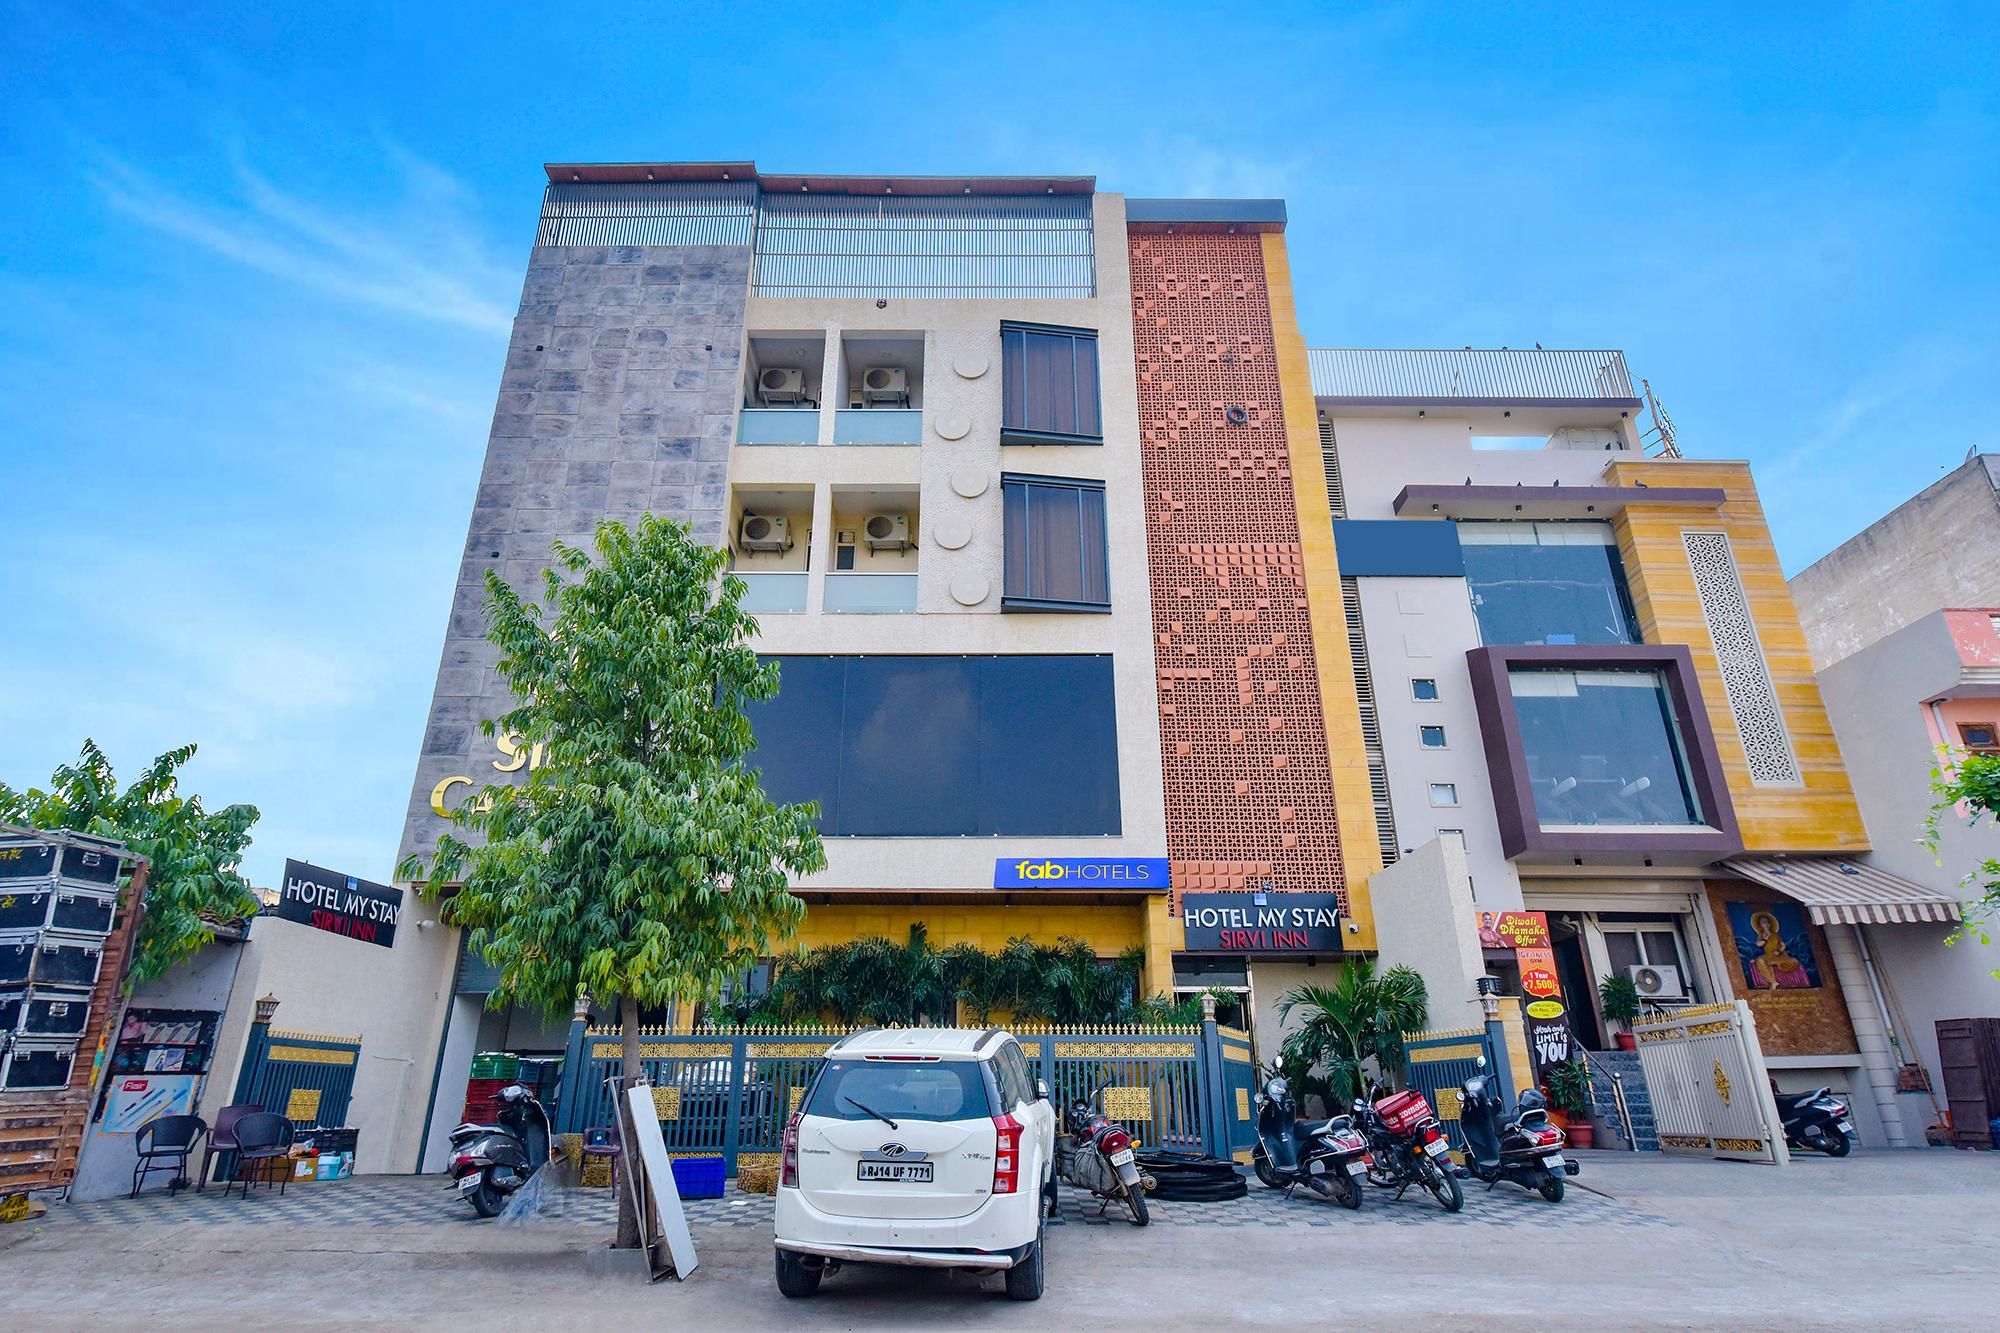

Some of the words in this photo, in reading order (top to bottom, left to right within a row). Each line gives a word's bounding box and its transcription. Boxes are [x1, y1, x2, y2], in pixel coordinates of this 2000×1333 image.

[1015, 860, 1149, 880] fabHOTELS
[286, 877, 341, 911] HOTEL
[343, 893, 369, 917] MY
[369, 899, 400, 925] STAY
[312, 908, 348, 937] SIRVI
[351, 918, 377, 942] INN
[1184, 908, 1249, 929] HOTEL
[1257, 908, 1285, 928] MY
[1291, 908, 1338, 928] STAY
[1506, 915, 1537, 926] Diwali
[1500, 924, 1546, 935] Dhamaka
[1220, 930, 1266, 949] SIRVI
[1272, 930, 1308, 949] INN
[1515, 935, 1537, 946] Offer
[1536, 1032, 1560, 1044] LIMIT
[1535, 1042, 1568, 1065] YOU
[125, 1081, 145, 1090] Flair
[1399, 1099, 1427, 1119] zomato
[867, 1165, 890, 1177] RJ14
[893, 1166, 905, 1178] UF
[907, 1167, 930, 1178] 7771
